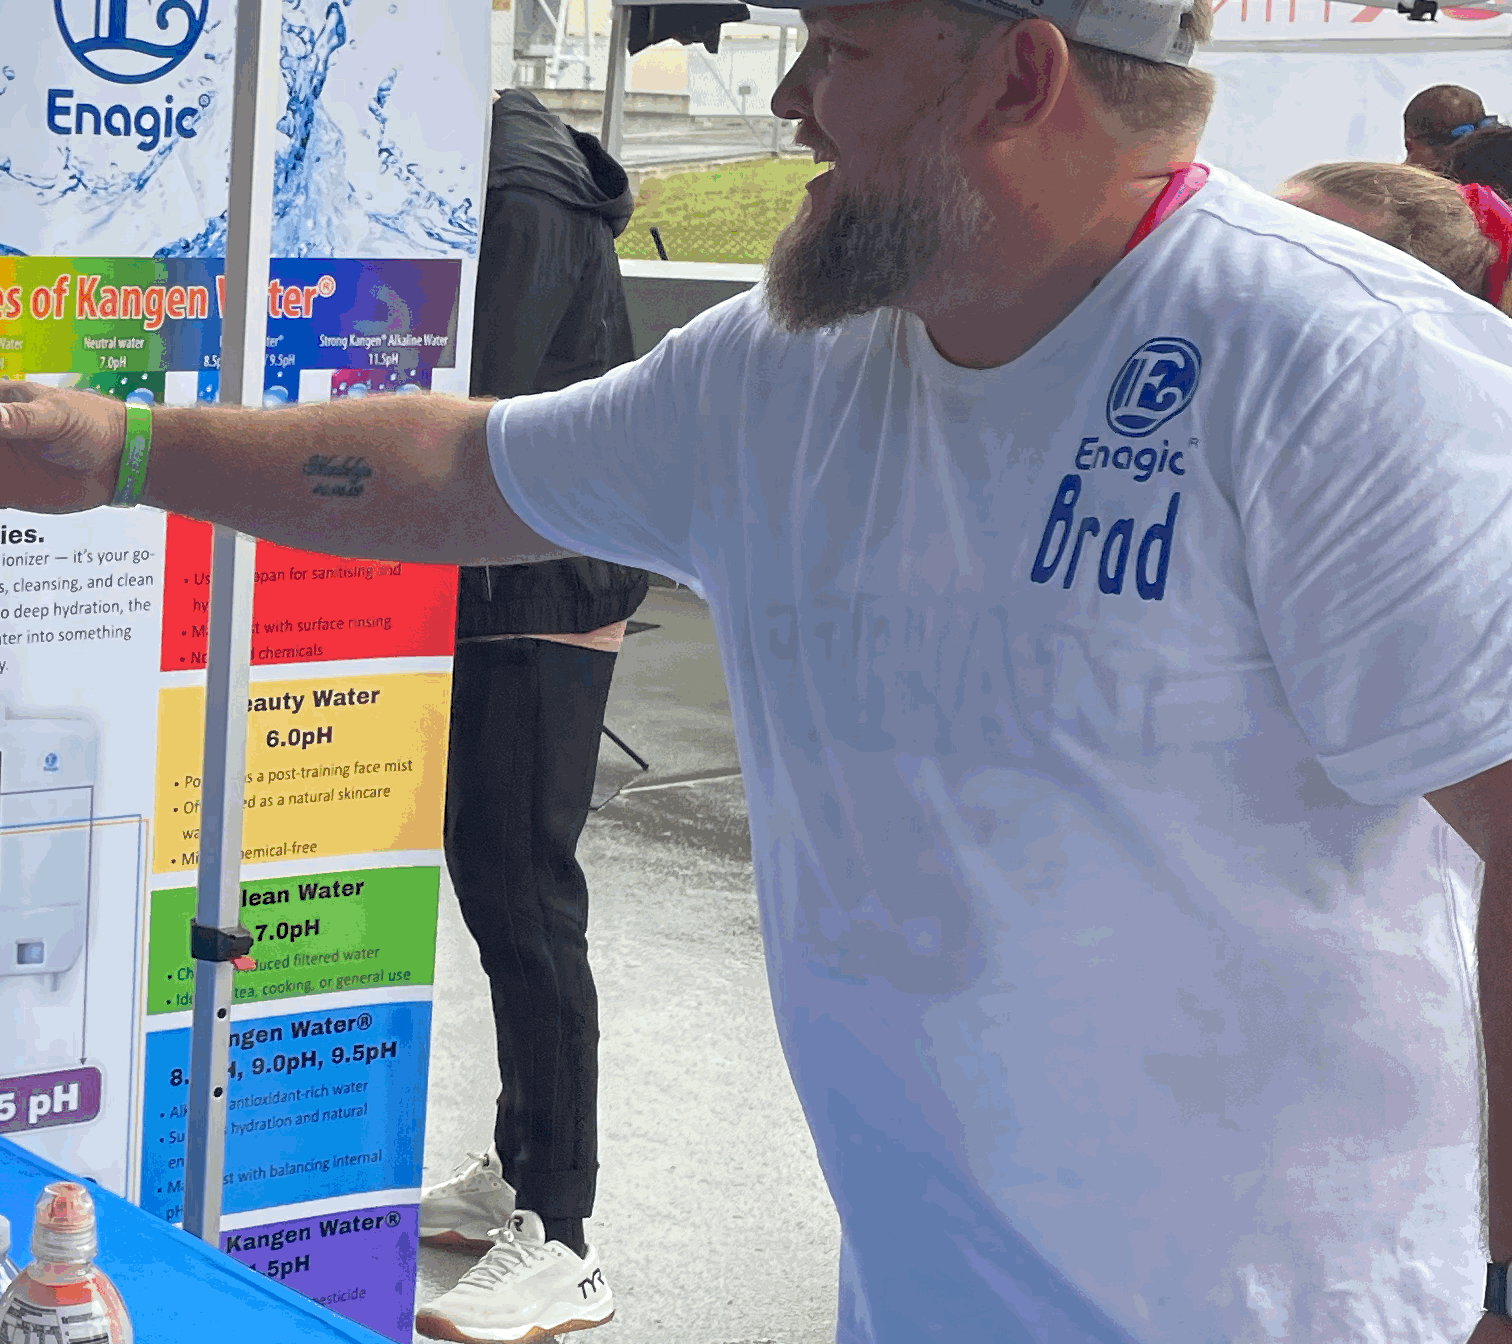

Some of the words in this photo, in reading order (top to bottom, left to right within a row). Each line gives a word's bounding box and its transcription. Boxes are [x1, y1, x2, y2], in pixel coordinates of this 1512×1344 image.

[31, 274, 70, 320] of
[76, 275, 208, 330] Kangen
[319, 334, 348, 350] Strong
[388, 333, 422, 348] Alkaline
[423, 333, 449, 348] Water
[1030, 473, 1180, 601] Brad
[2, 552, 50, 567] ionizer
[97, 551, 129, 565] your
[13, 577, 83, 593] cleansing,
[87, 574, 113, 589] and
[117, 572, 154, 587] clean
[289, 567, 308, 582] for
[14, 604, 49, 622] deep
[53, 599, 124, 620] hydration,
[128, 598, 151, 612] the
[26, 629, 54, 644] into
[58, 625, 132, 642] something
[264, 618, 293, 634] with
[297, 616, 344, 633] surface
[348, 614, 392, 631] rinsing
[258, 644, 324, 661] chemicals
[247, 691, 305, 714] eauty
[313, 688, 381, 708] Water
[266, 726, 333, 749] 6.0pH
[268, 762, 350, 786] post-training
[354, 759, 380, 774] face
[384, 758, 413, 773] mist
[259, 796, 274, 809] as
[276, 794, 285, 806] a
[288, 788, 335, 805] natural
[338, 785, 391, 801] skincare
[242, 888, 289, 907] lean
[298, 880, 365, 903] Water
[255, 919, 321, 943] 7.0pH
[293, 949, 339, 966] filtered
[343, 947, 380, 961] water
[319, 978, 332, 990] or
[336, 970, 384, 990] general
[388, 969, 411, 982] use
[228, 1026, 283, 1049] ngen
[252, 1050, 324, 1075] 9.0pH,
[331, 1041, 397, 1064] 9.5pH
[29, 1083, 79, 1123] pH
[229, 1085, 329, 1111] antioxidant-rich
[332, 1080, 368, 1096] water
[231, 1114, 292, 1137] hydration
[295, 1109, 319, 1125] and
[322, 1103, 367, 1122] natural
[238, 1163, 266, 1183] with
[270, 1155, 330, 1177] balancing
[333, 1149, 382, 1167] internal
[226, 1225, 311, 1254] Kangen
[578, 1268, 605, 1299] TYR
